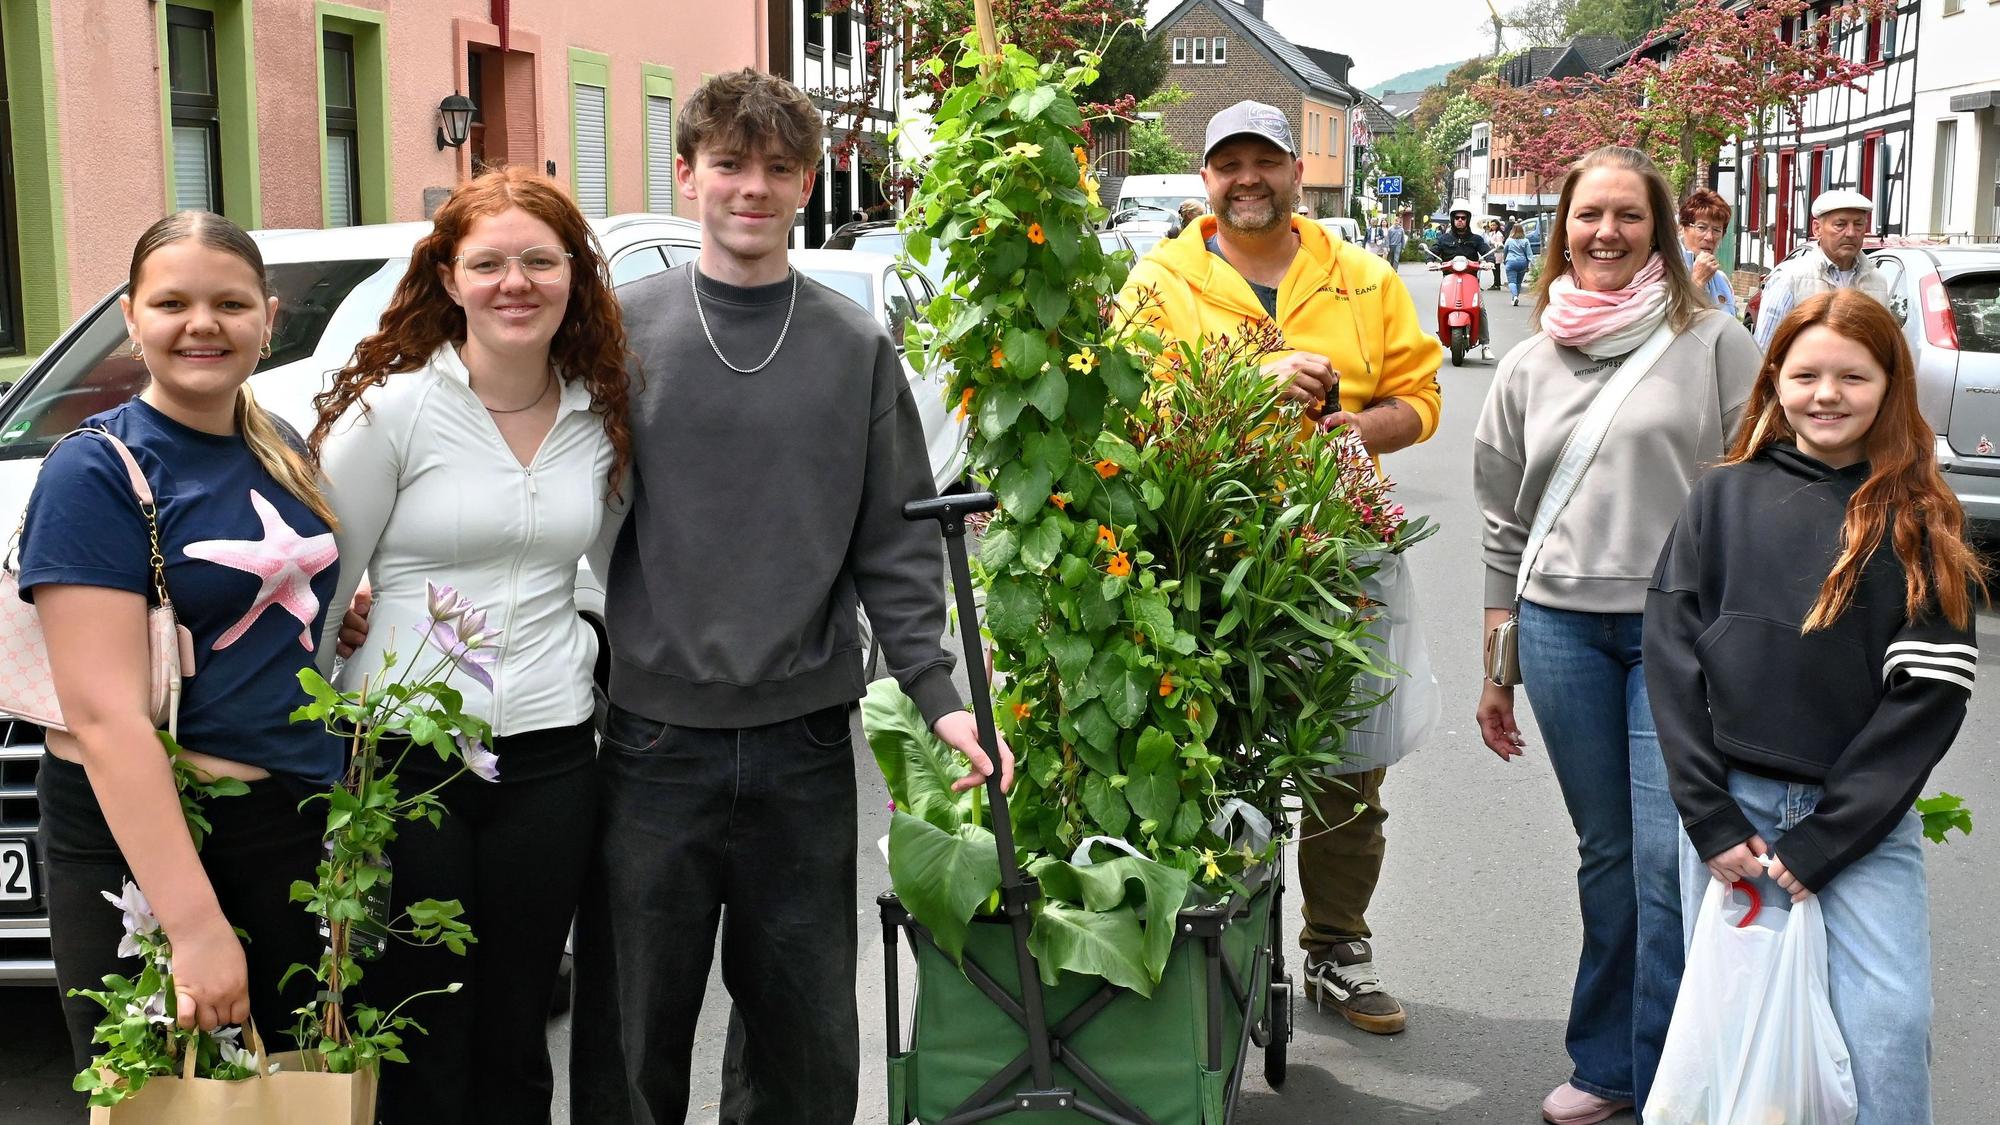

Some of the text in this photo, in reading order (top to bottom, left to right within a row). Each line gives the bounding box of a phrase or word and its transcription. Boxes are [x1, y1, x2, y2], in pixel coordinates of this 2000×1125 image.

[1355, 284, 1378, 296] EANS
[1965, 386, 2000, 395] FOCU
[0, 849, 27, 893] 2
